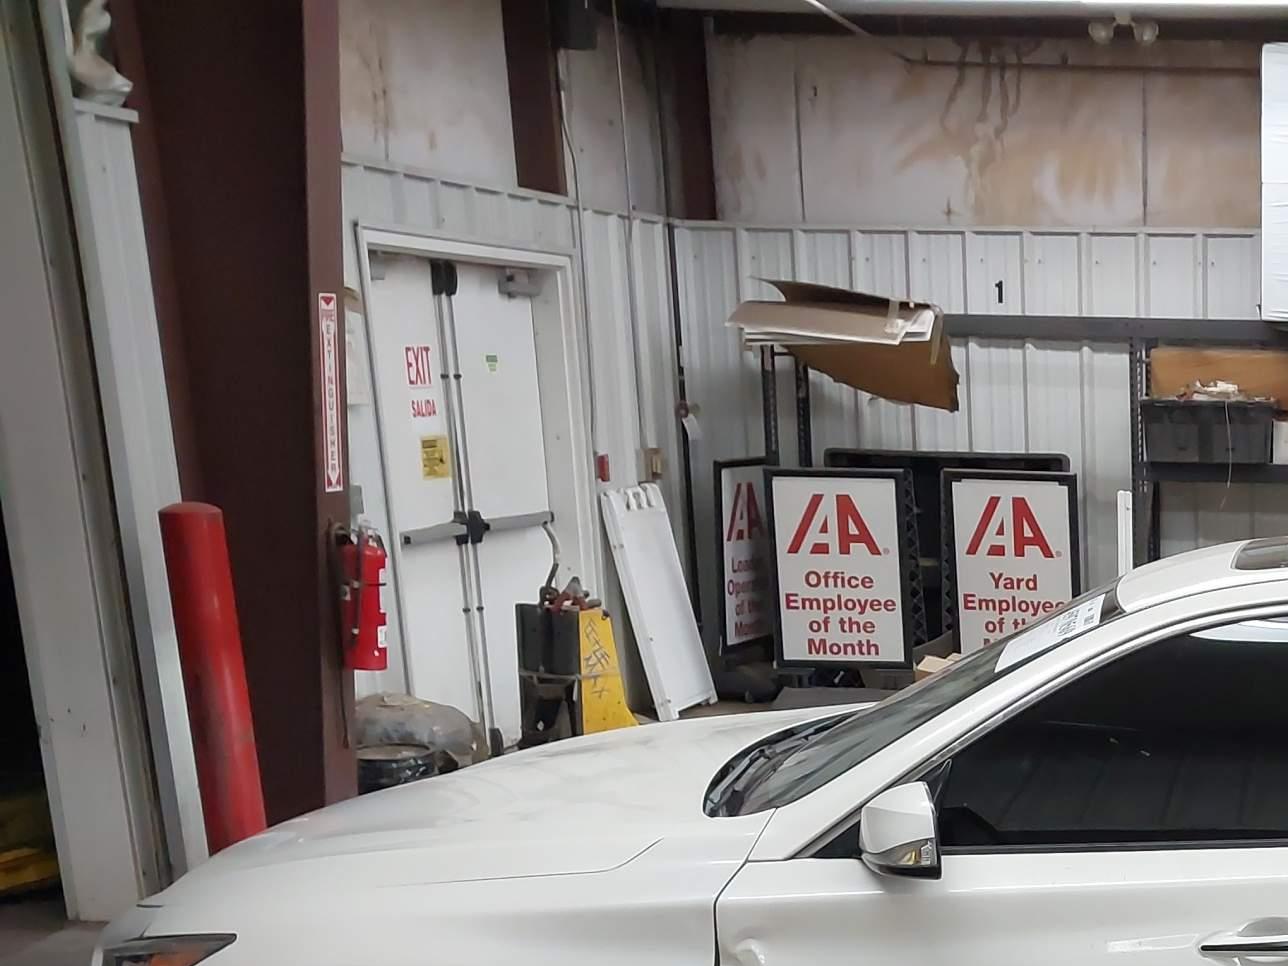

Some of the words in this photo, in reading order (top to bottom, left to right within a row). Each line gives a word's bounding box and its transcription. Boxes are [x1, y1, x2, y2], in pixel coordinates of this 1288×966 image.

[995, 279, 1003, 304] 1
[405, 346, 431, 385] EXIT
[411, 399, 437, 418] SALIDA
[804, 570, 874, 589] Office
[989, 572, 1038, 592] Yard
[785, 593, 897, 616] Employee
[808, 616, 831, 633] of
[839, 617, 876, 634] the
[985, 618, 1005, 634] of
[807, 638, 880, 657] Month
